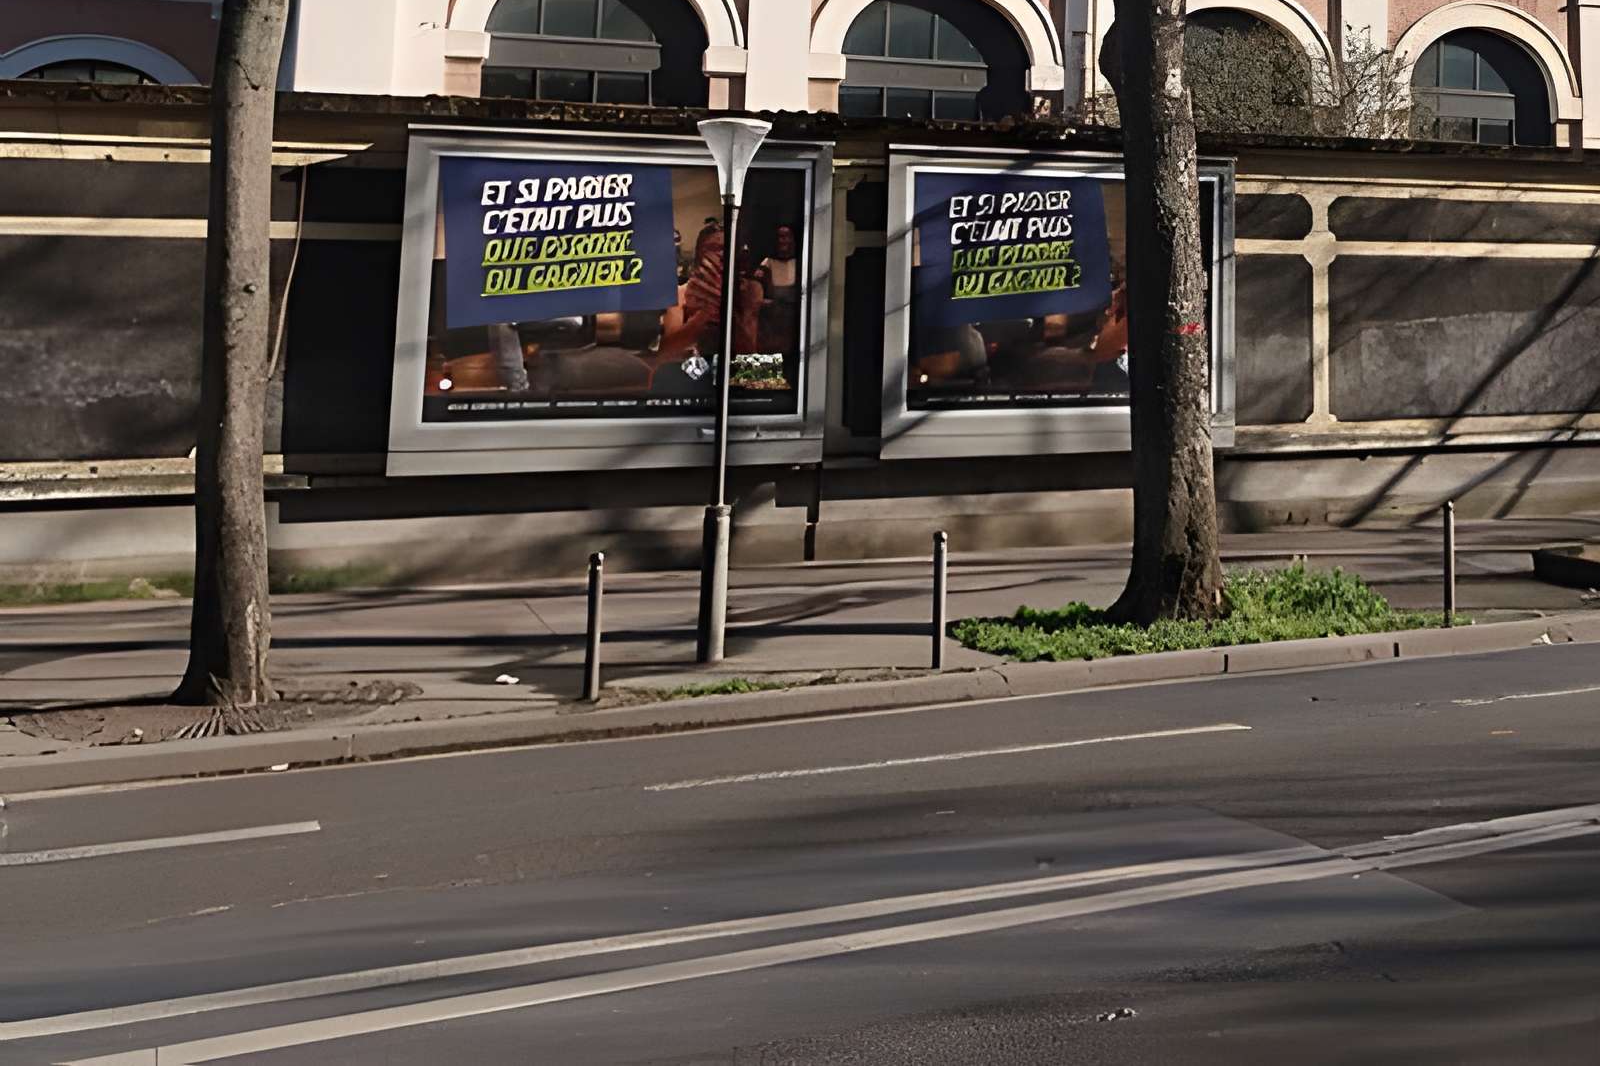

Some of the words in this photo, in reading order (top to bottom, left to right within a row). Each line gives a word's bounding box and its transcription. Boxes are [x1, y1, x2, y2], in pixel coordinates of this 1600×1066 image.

[481, 180, 511, 205] ET
[576, 202, 636, 228] PLUS
[949, 195, 973, 218] ET
[485, 266, 523, 293] OU
